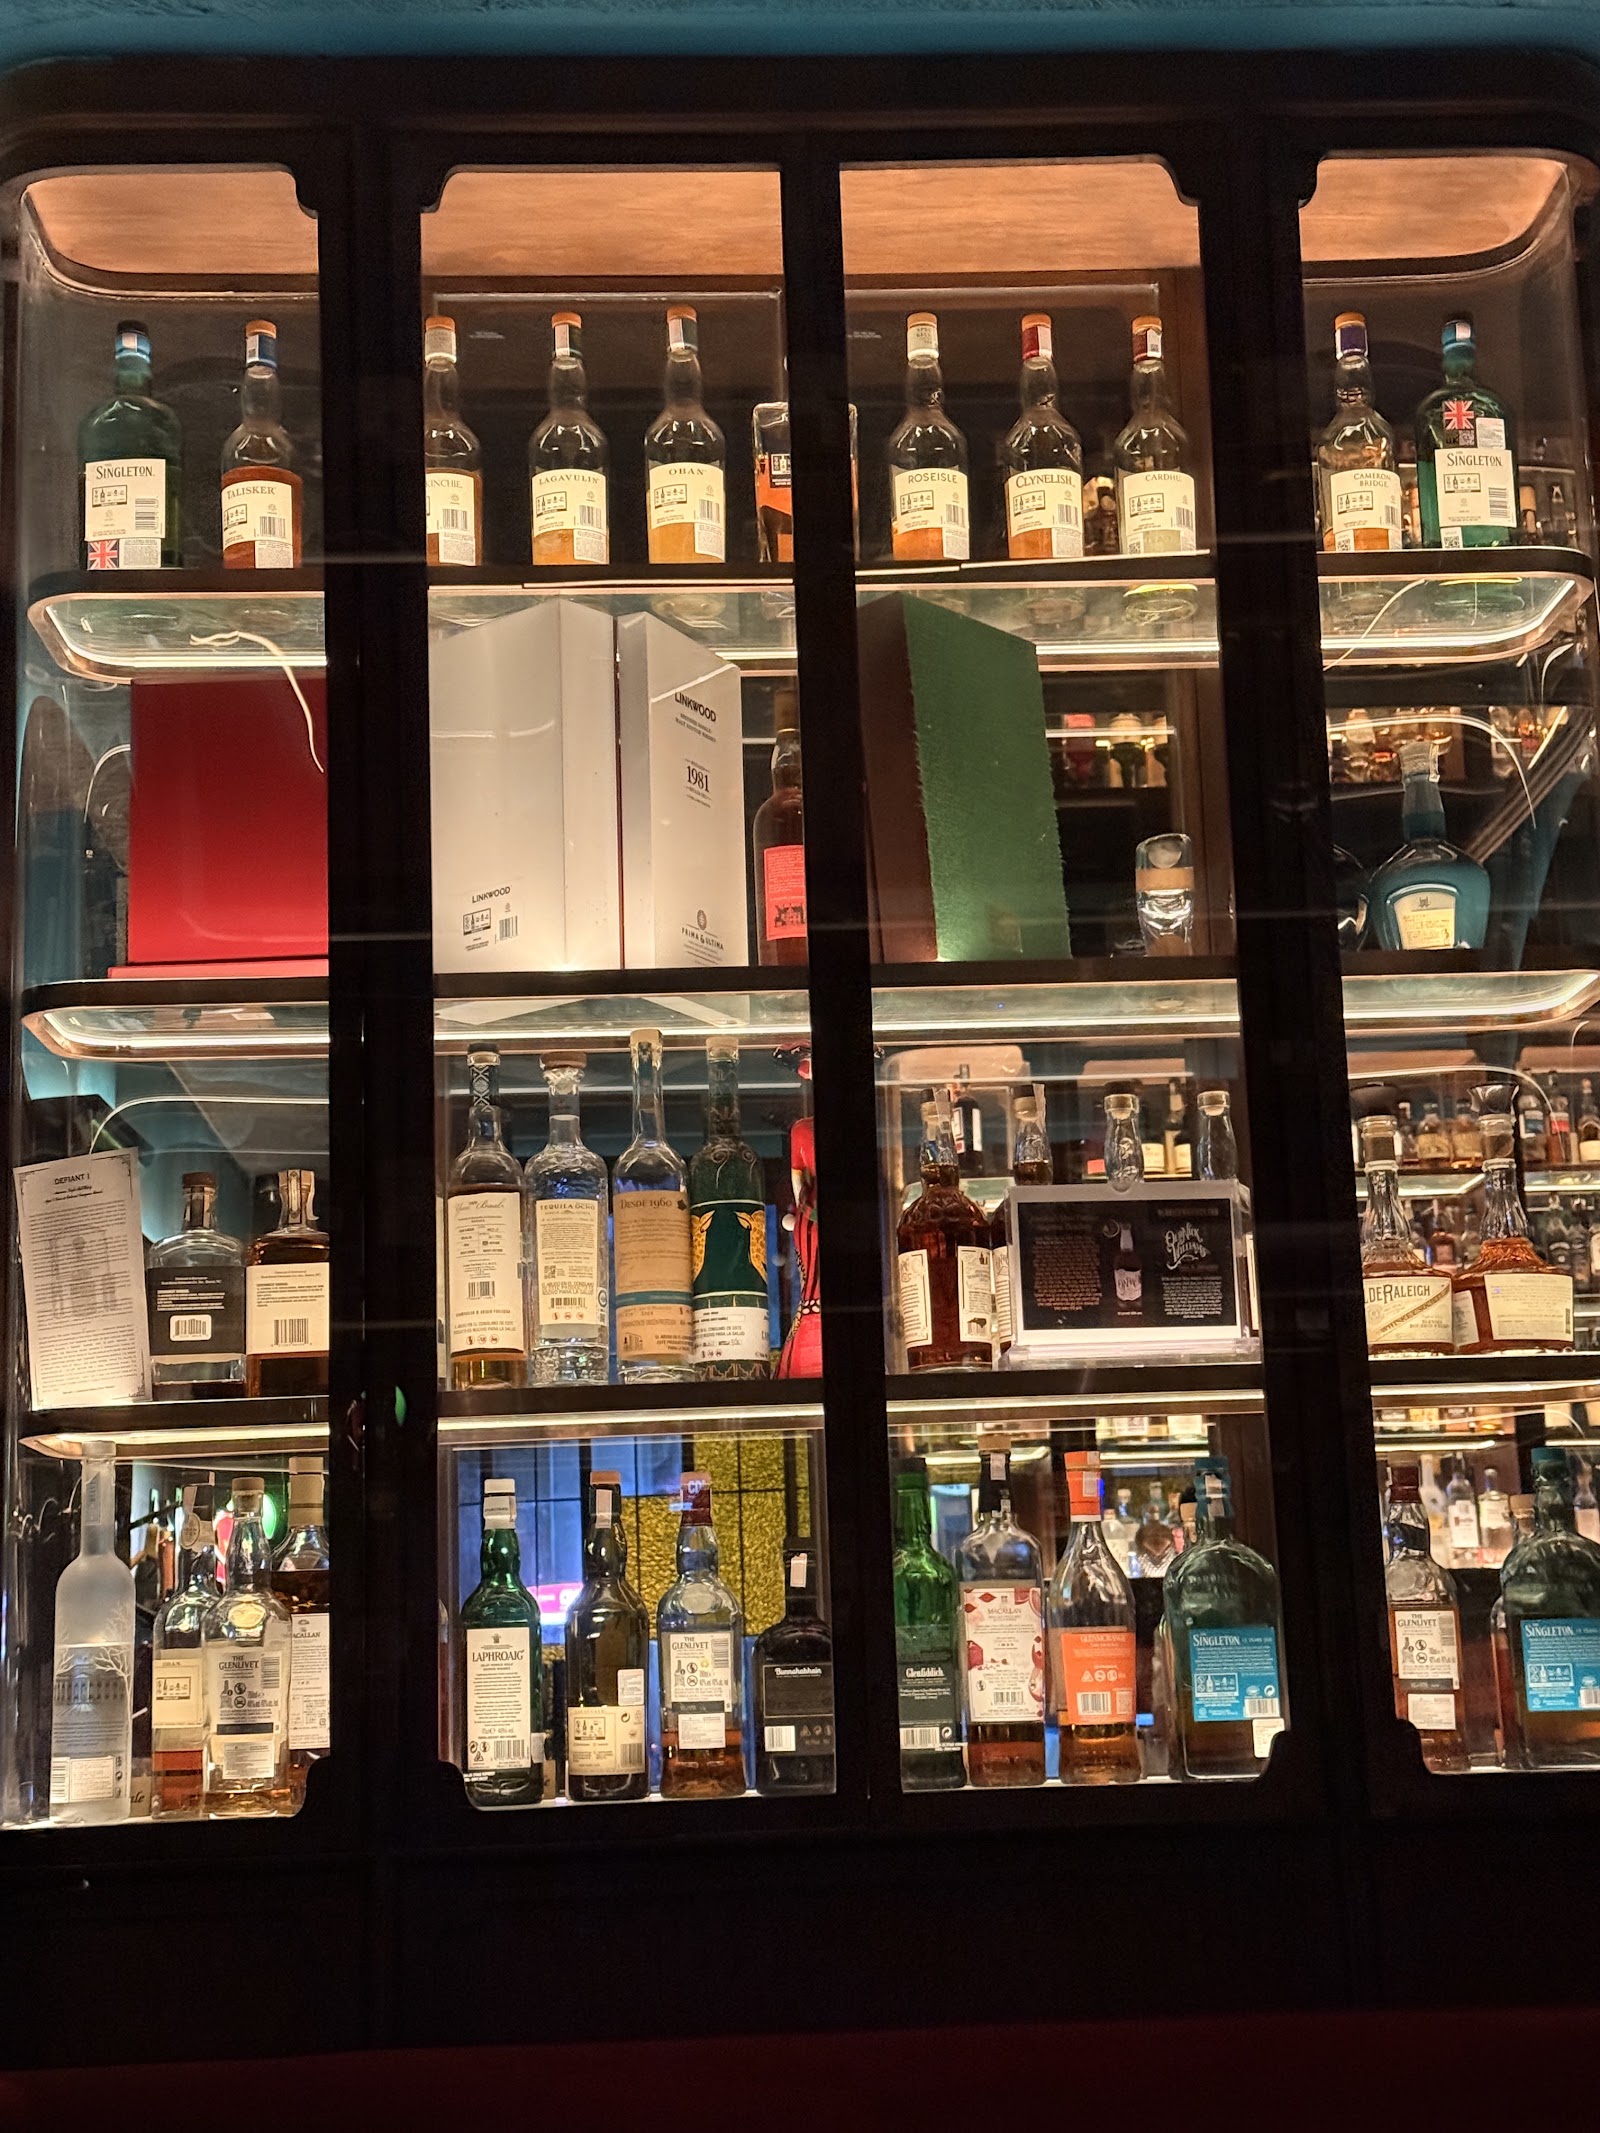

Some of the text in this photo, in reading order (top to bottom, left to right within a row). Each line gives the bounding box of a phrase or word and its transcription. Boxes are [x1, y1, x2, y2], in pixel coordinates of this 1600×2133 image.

[1447, 452, 1503, 467] SINGLETON
[96, 465, 153, 480] SINGLETON
[669, 467, 704, 476] OBAN
[1353, 472, 1391, 480] CAMERON
[539, 474, 599, 486] LAGAVULIN
[908, 472, 958, 484] ROSEISLE
[1016, 474, 1073, 488] CLYNELISH
[1145, 473, 1182, 482] CARDHU
[1360, 480, 1389, 488] BRIDGE
[226, 486, 275, 499] TALISKER
[675, 692, 717, 722] LINKWOOD
[687, 765, 710, 793] 1981
[472, 886, 511, 903] LINKWOOD
[54, 1174, 84, 1185] DEFIANT
[540, 1203, 573, 1211] TEQUILA
[650, 1197, 673, 1209] 1960
[1397, 1619, 1437, 1628] GLENLIVET
[293, 1631, 320, 1639] ACALLAN
[1525, 1625, 1574, 1637] SINGLETON
[672, 1641, 709, 1650] GLENLIVET
[1193, 1634, 1240, 1647] SINGLETON
[472, 1651, 522, 1662] LAPHROAIG
[219, 1660, 259, 1670] GLENLIVET
[906, 1667, 945, 1678] Glenfiddich
